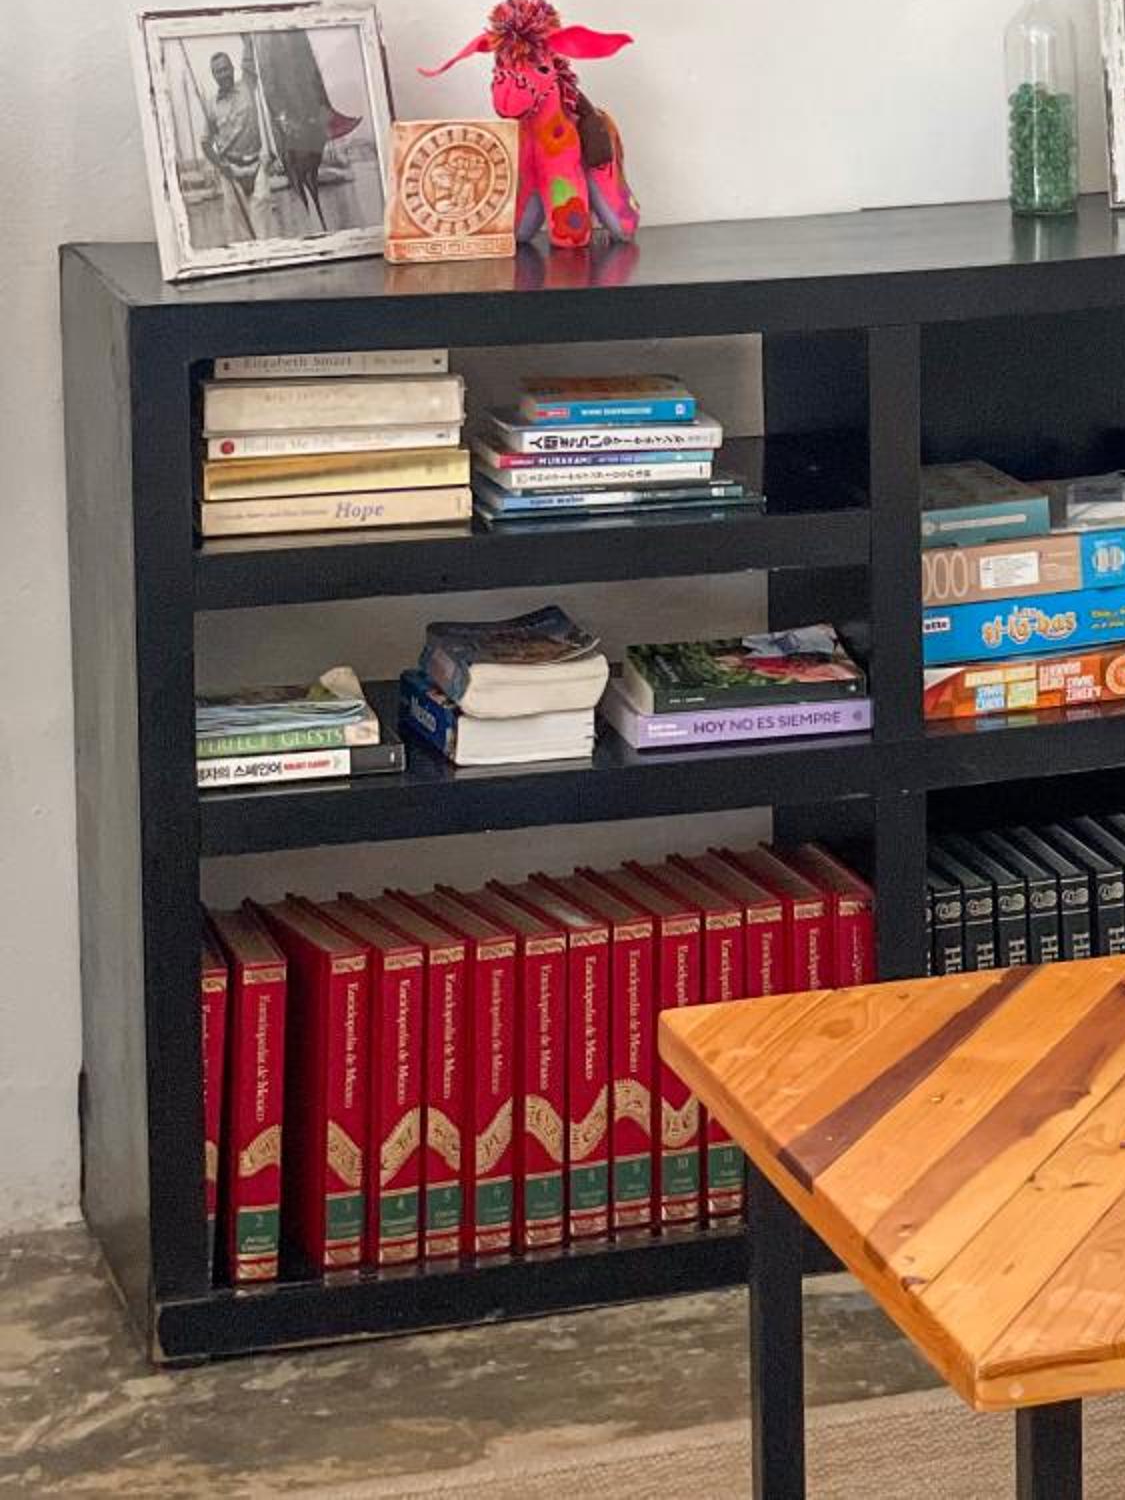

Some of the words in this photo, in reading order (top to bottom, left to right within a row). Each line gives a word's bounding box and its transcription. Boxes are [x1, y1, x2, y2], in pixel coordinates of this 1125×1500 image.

[243, 357, 309, 369] Elizabeth
[310, 355, 353, 367] Smart
[335, 501, 385, 522] Hope
[693, 719, 726, 735] HOY
[729, 717, 754, 732] NO
[757, 715, 775, 730] ES
[778, 711, 842, 727] SIEMPRE
[281, 728, 343, 746] GUESTS
[585, 1024, 596, 1036] de
[630, 1018, 640, 1030] de
[492, 1040, 502, 1051] de
[541, 1035, 551, 1046] de
[444, 1043, 455, 1056] de
[346, 1054, 357, 1065] de
[399, 1050, 409, 1062] de
[257, 1066, 268, 1077] de
